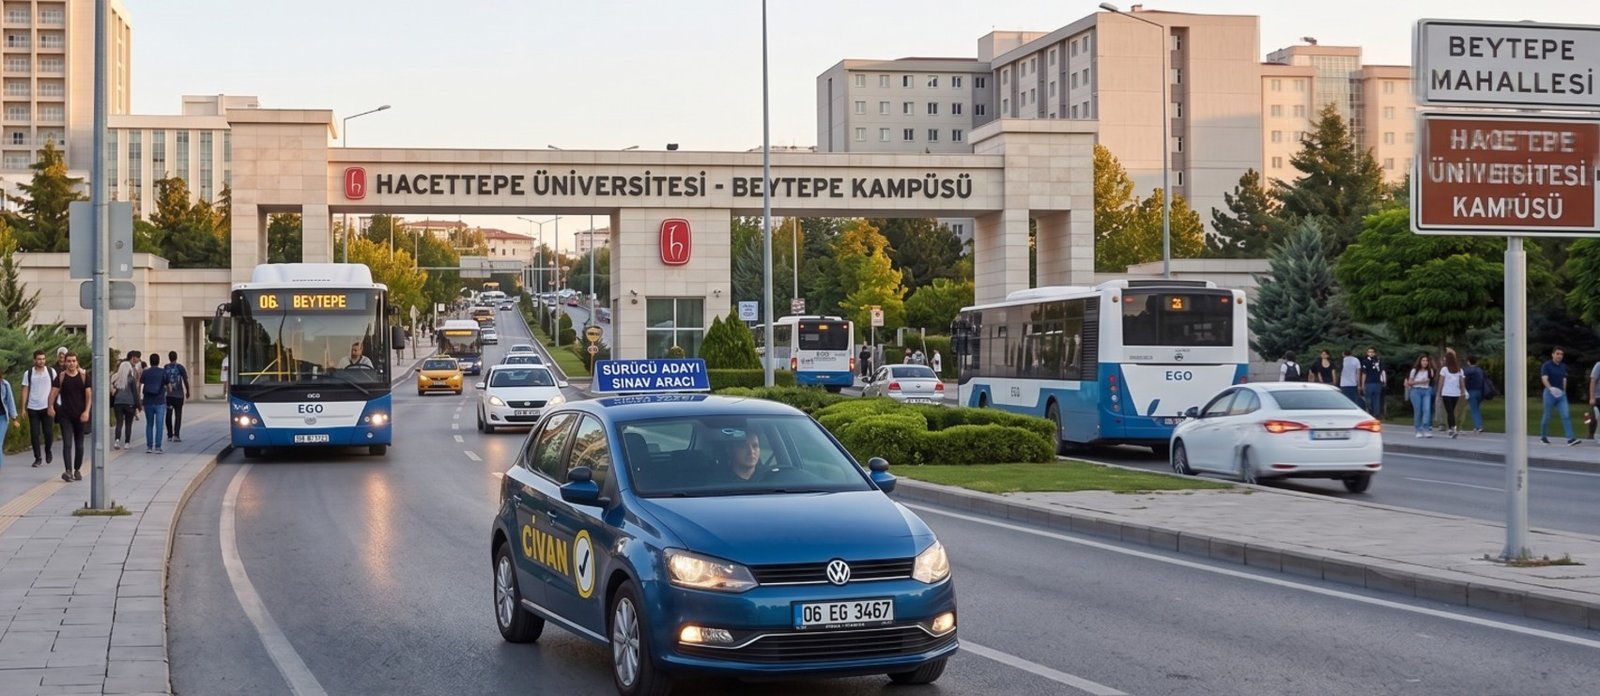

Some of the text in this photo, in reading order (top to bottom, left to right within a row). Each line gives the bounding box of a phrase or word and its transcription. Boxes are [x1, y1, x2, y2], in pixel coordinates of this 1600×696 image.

[1449, 36, 1575, 61] BEYTEPE
[1431, 68, 1593, 95] MAHALLESİ
[376, 174, 525, 195] HACETTEPE
[533, 170, 706, 197] ÜNİVERSİTESİ
[732, 177, 844, 198] BEYTEPE
[852, 173, 973, 199] KAMPÜSÜ
[293, 295, 346, 308] BEYTEPE
[603, 361, 700, 375] SÜRÜCÜ ADAYI
[612, 376, 695, 389] SINAV ARACI
[1165, 370, 1193, 381] EGO
[298, 404, 324, 414] EGO
[803, 601, 891, 623] 06 EG 3467
